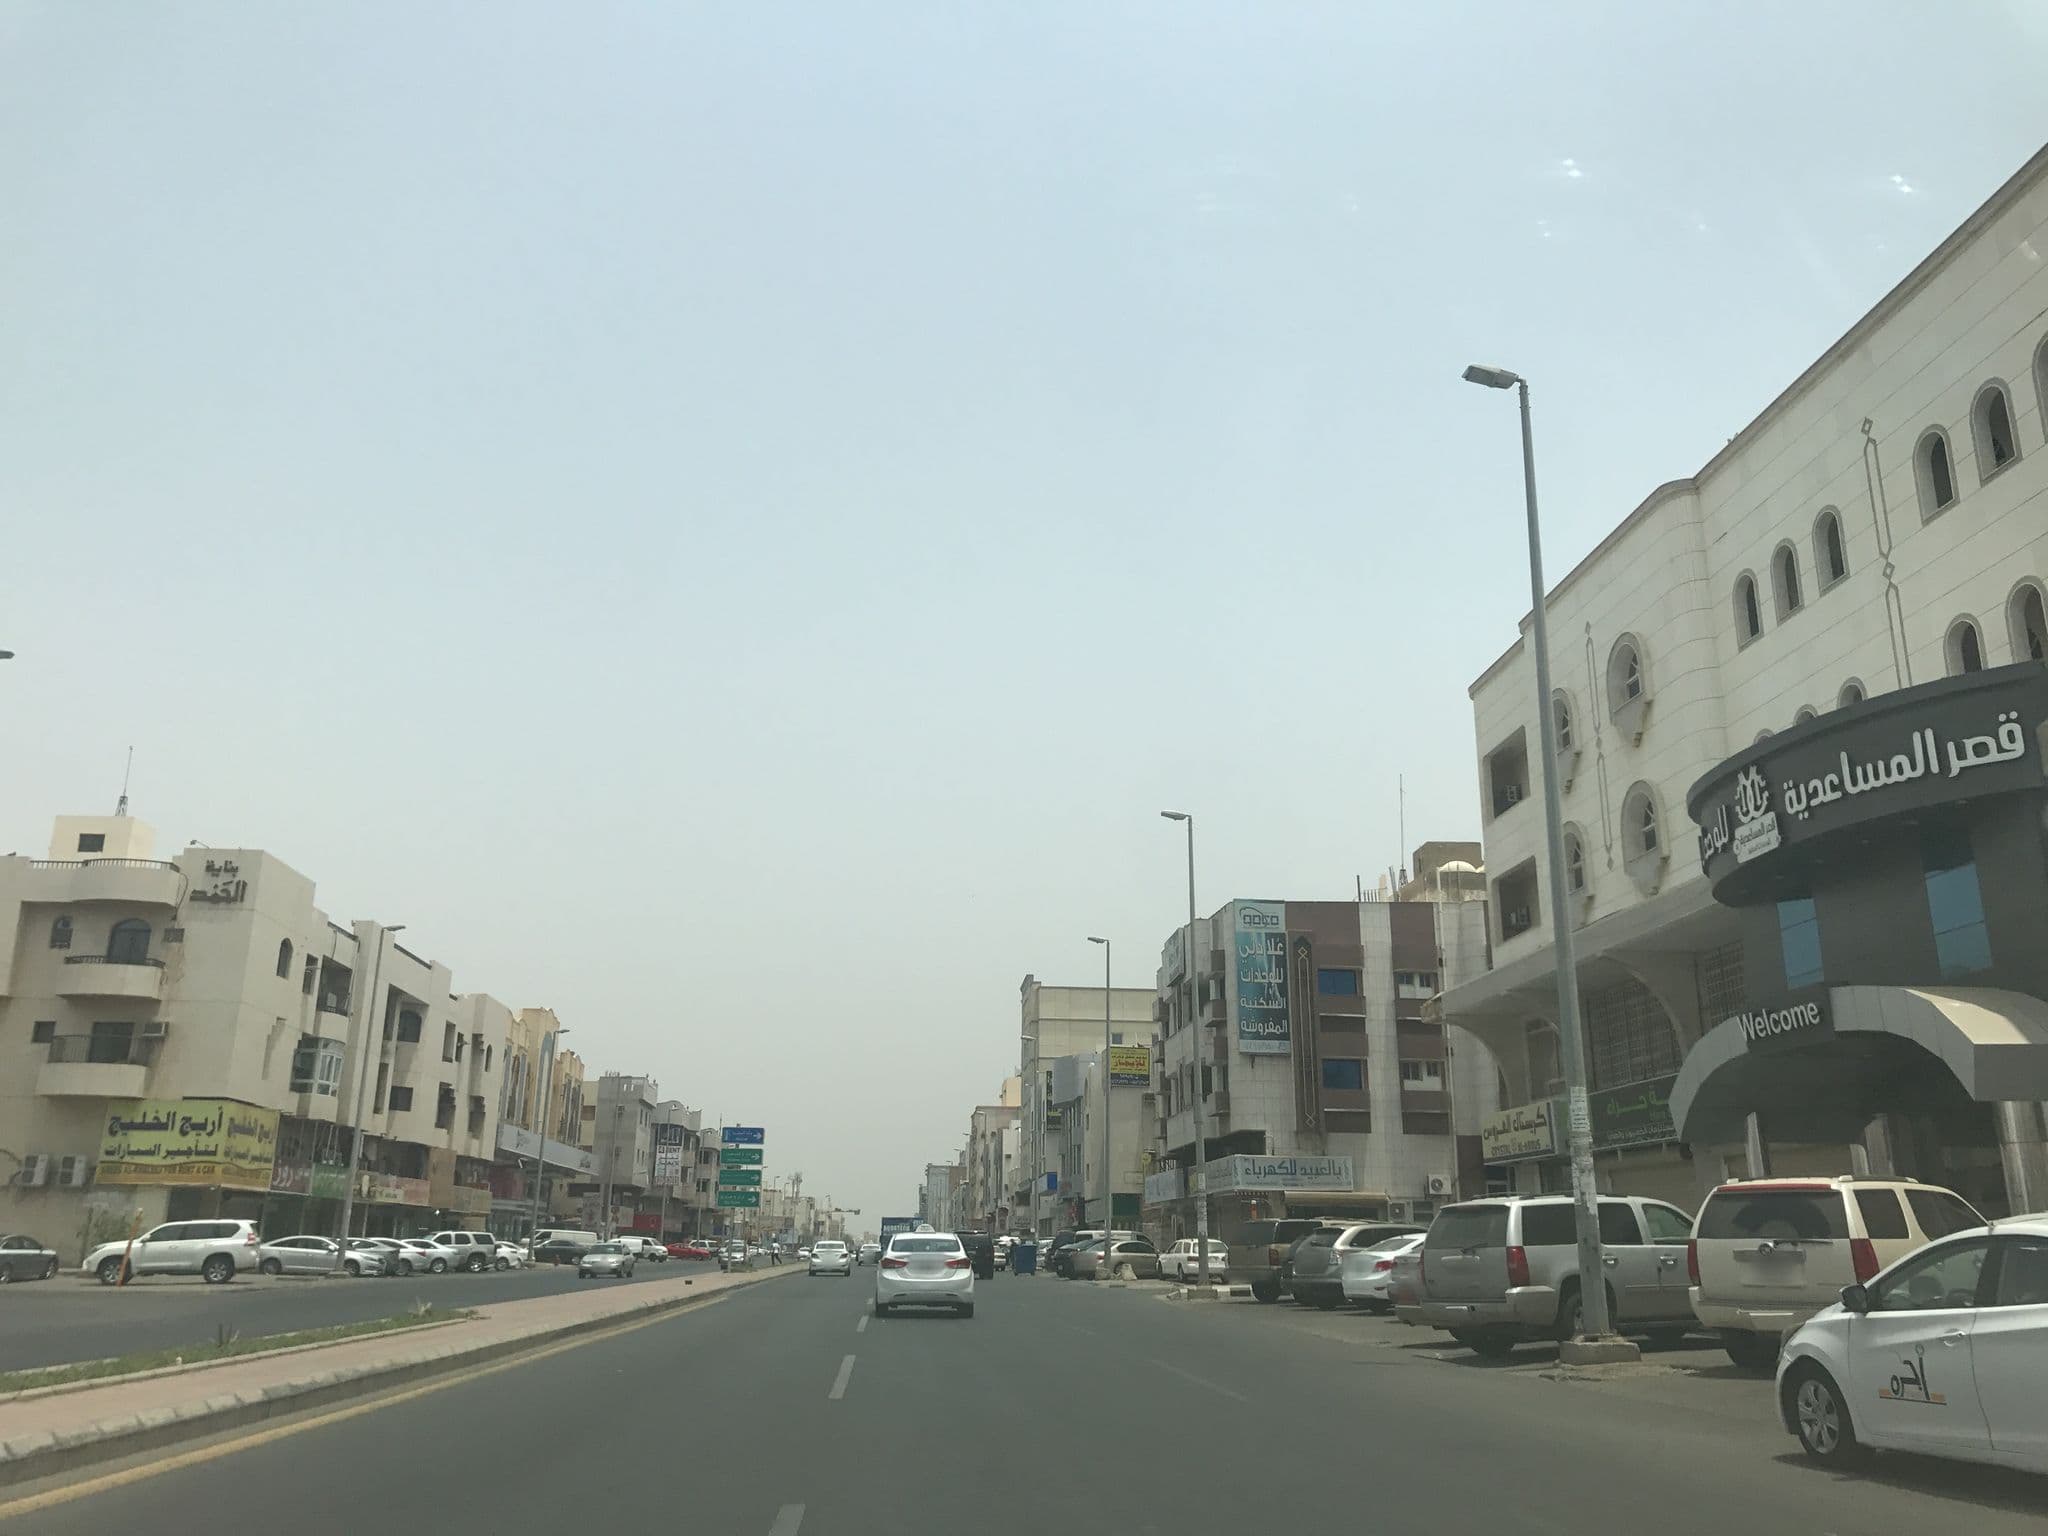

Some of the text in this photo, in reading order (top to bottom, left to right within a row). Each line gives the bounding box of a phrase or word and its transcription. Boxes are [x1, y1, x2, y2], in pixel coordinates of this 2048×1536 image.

[1783, 711, 2025, 820] قصر المساعدية
[205, 860, 239, 878] بناية
[1240, 967, 1284, 985] للوحدات
[1240, 994, 1287, 1011] السكنية
[1240, 1016, 1288, 1036] المفروشة
[1737, 1003, 1820, 1040] Welcome
[108, 1105, 224, 1137] أريج الخليج
[1513, 1105, 1547, 1135] كريستال
[104, 1139, 219, 1160] لتأجير السيارات
[1244, 1157, 1297, 1180] للكهرباء
